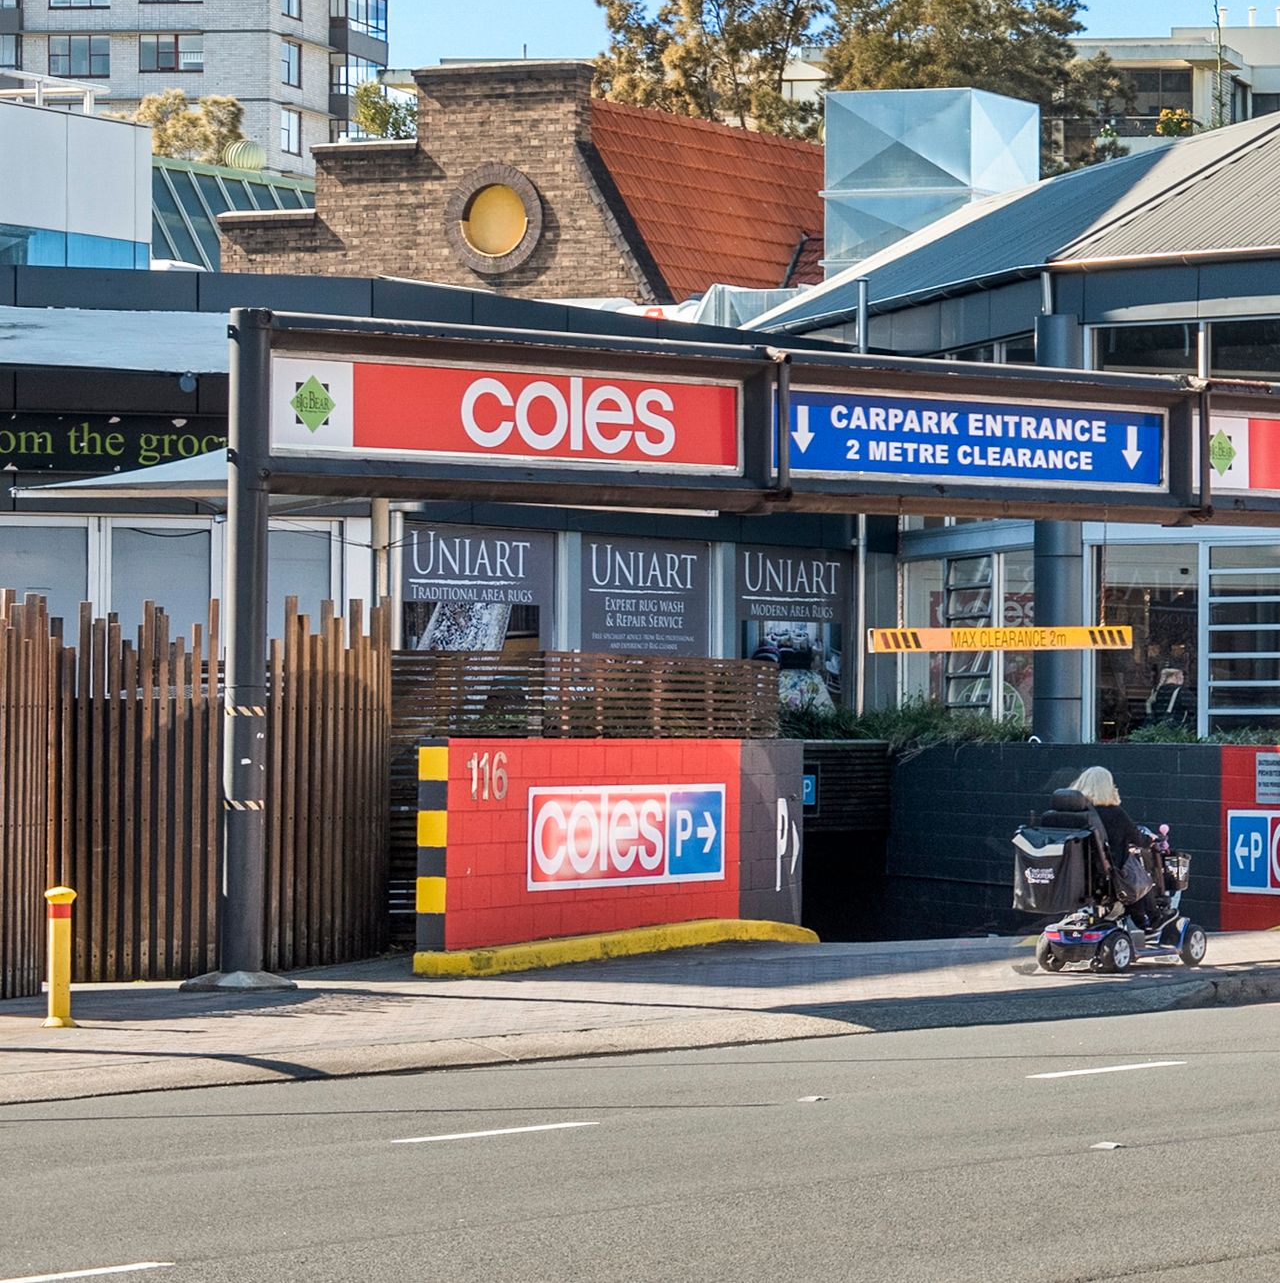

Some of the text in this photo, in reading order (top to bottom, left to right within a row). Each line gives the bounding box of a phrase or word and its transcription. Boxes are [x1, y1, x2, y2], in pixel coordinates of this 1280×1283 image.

[461, 377, 676, 456] coles
[830, 404, 1107, 442] CARPARK ENTRANCE
[67, 422, 125, 456] the
[846, 439, 1093, 470] 2 METRE CLEARANCE
[411, 530, 531, 578] UNIART
[590, 544, 697, 588] UNIART
[744, 551, 840, 594] UNIART
[411, 584, 533, 602] TRADITIONAL AREA RUGS
[605, 597, 684, 613] EXPERT RUG WASH
[751, 603, 834, 618] MODERN AREA RUGS
[606, 613, 683, 629] & REPAIR SERVICE
[951, 630, 1066, 648] MAX CLEARANCE 2m
[467, 751, 508, 801] 116
[803, 779, 812, 801] P
[534, 791, 693, 875] coles P
[1251, 832, 1262, 871] P
